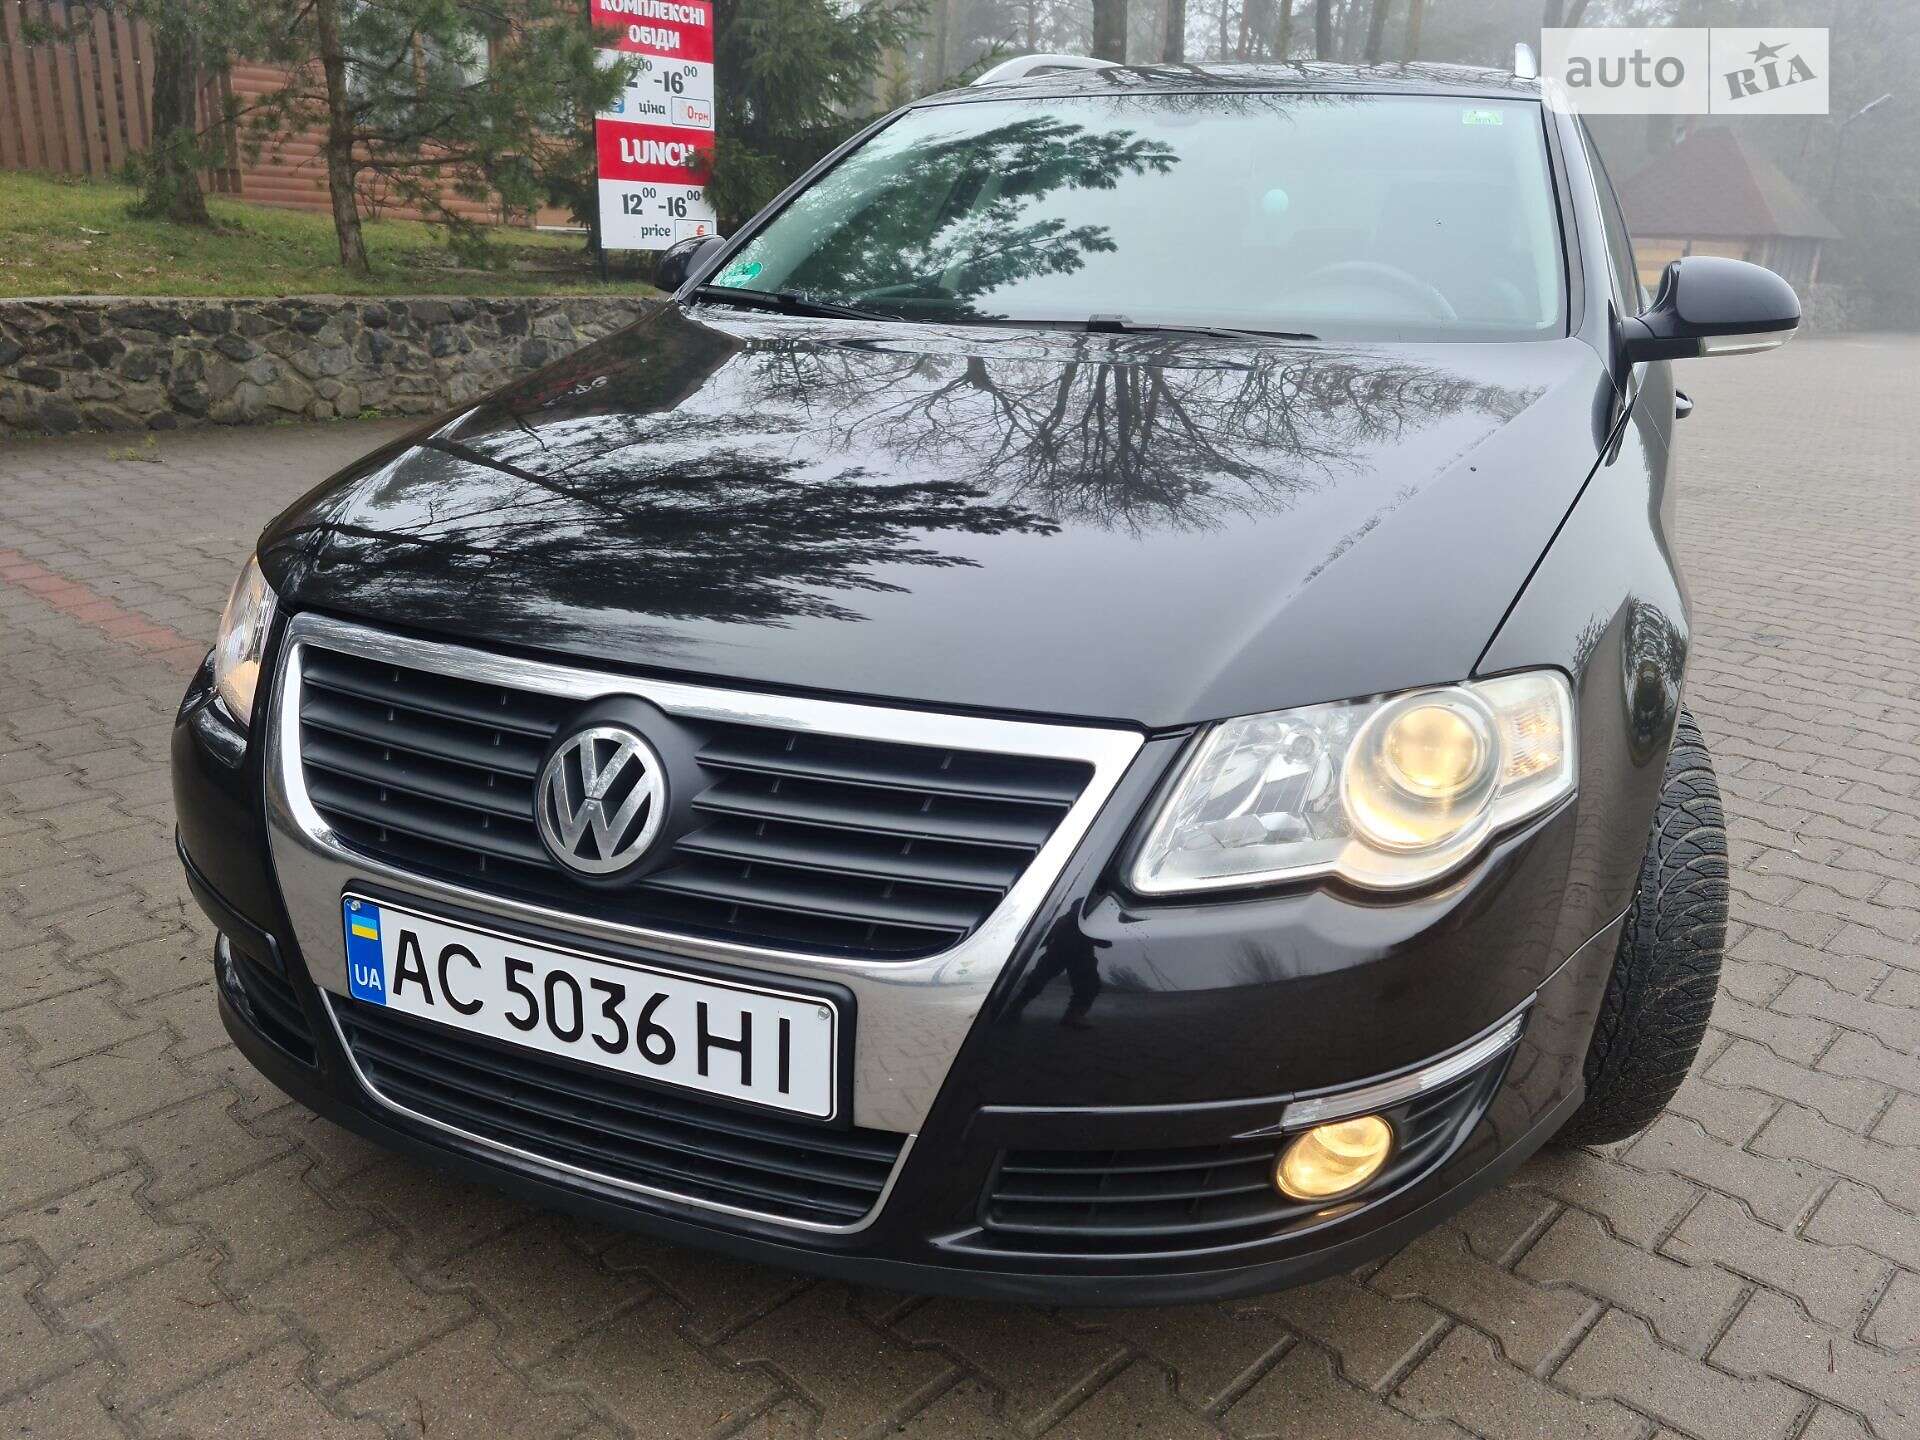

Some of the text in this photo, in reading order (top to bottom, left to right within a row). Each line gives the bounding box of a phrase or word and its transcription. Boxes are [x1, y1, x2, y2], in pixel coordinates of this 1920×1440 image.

[600, 0, 706, 26] КОМПЛЕКСНІ
[628, 24, 680, 51] ОБІДИ
[638, 100, 666, 115] ціна
[641, 224, 671, 239] price
[354, 963, 382, 991] UA
[392, 928, 791, 1094] AC 5036 HI
